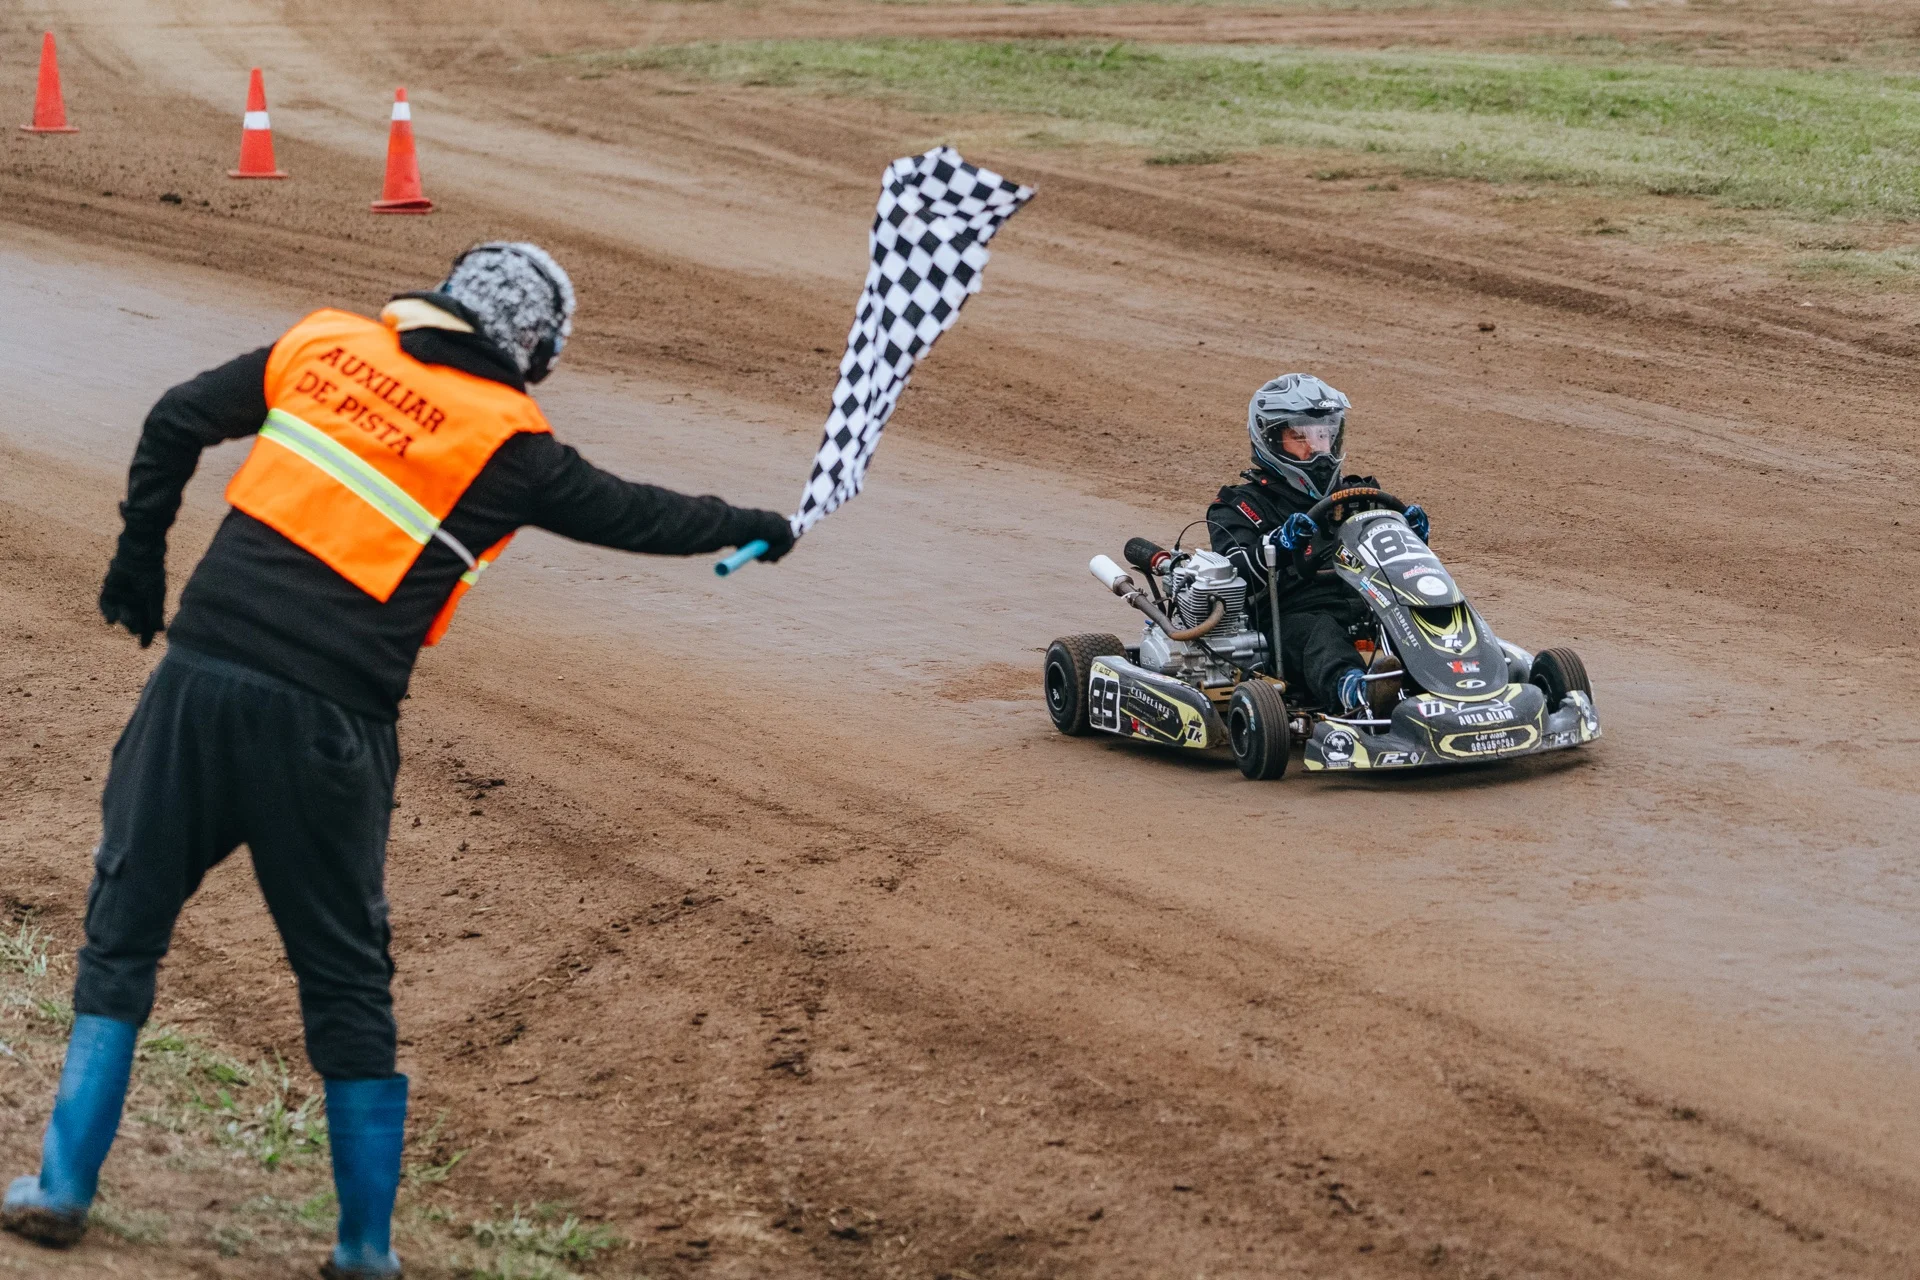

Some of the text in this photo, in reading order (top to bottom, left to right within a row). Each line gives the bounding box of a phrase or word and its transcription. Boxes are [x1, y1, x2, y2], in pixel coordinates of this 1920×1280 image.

[295, 371, 414, 457] DE PISTA
[320, 347, 446, 433] AUXILIAR
[1458, 714, 1484, 726] AUTO
[1475, 731, 1507, 742] Car wash
